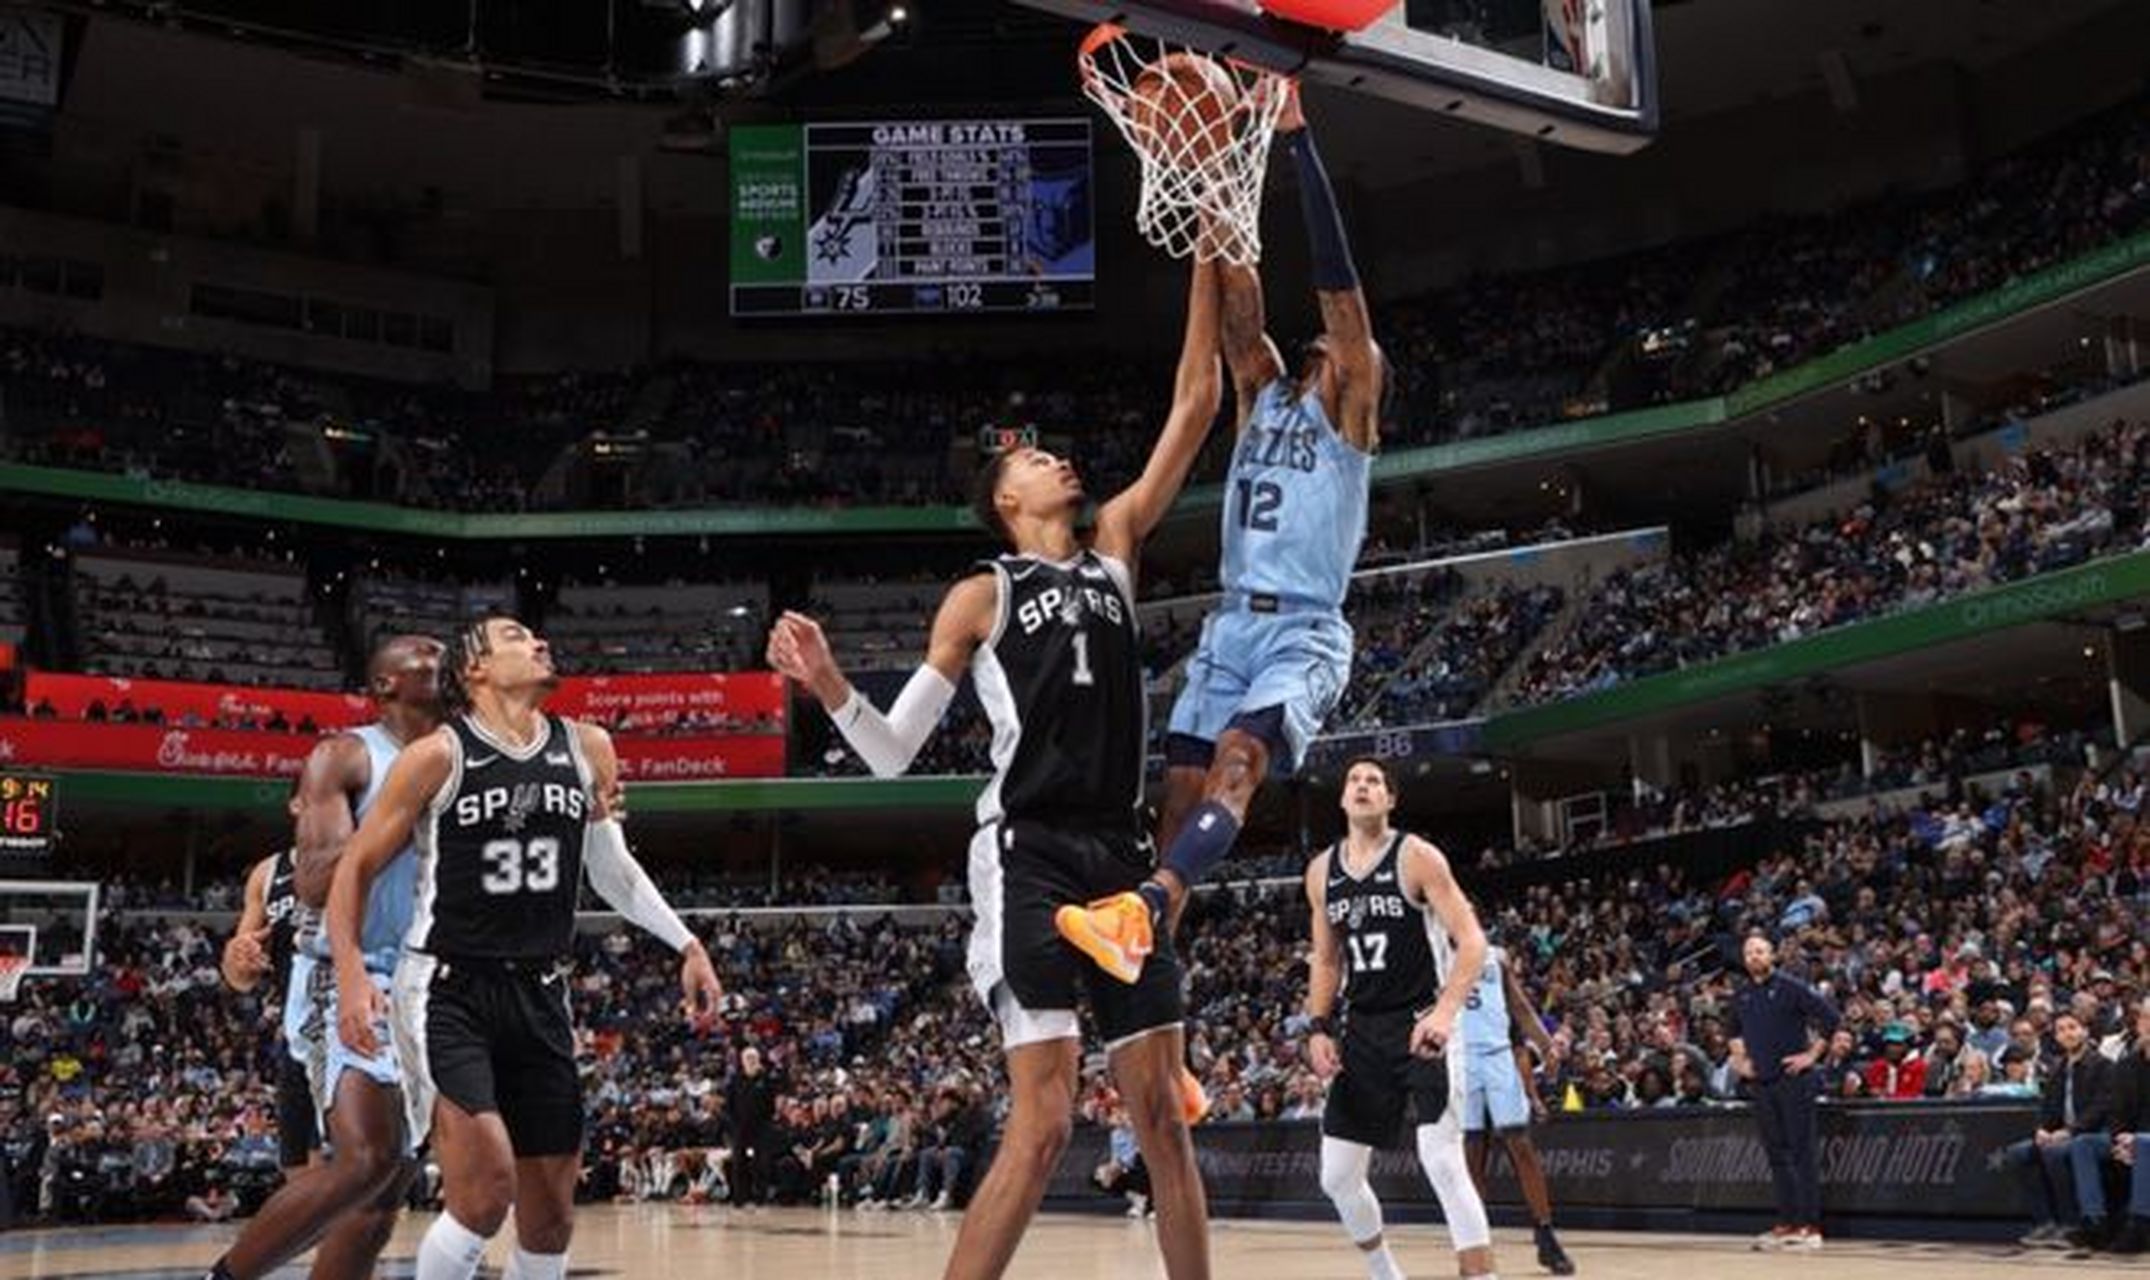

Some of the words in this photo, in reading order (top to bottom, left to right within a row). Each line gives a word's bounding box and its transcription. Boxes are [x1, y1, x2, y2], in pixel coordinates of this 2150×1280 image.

[872, 127, 945, 145] GAME
[948, 125, 1025, 144] STATS
[738, 184, 798, 197] SPORTS
[836, 287, 870, 309] 75
[946, 286, 982, 308] 102
[1237, 477, 1283, 533] 12
[1017, 585, 1123, 636] SPURS
[1070, 630, 1094, 686] 1
[640, 755, 726, 774] FanDeck
[4, 800, 39, 833] 16
[456, 782, 584, 828] SPURS
[482, 835, 559, 894] 33
[1327, 894, 1404, 926] SPURS
[1348, 933, 1388, 972] 17
